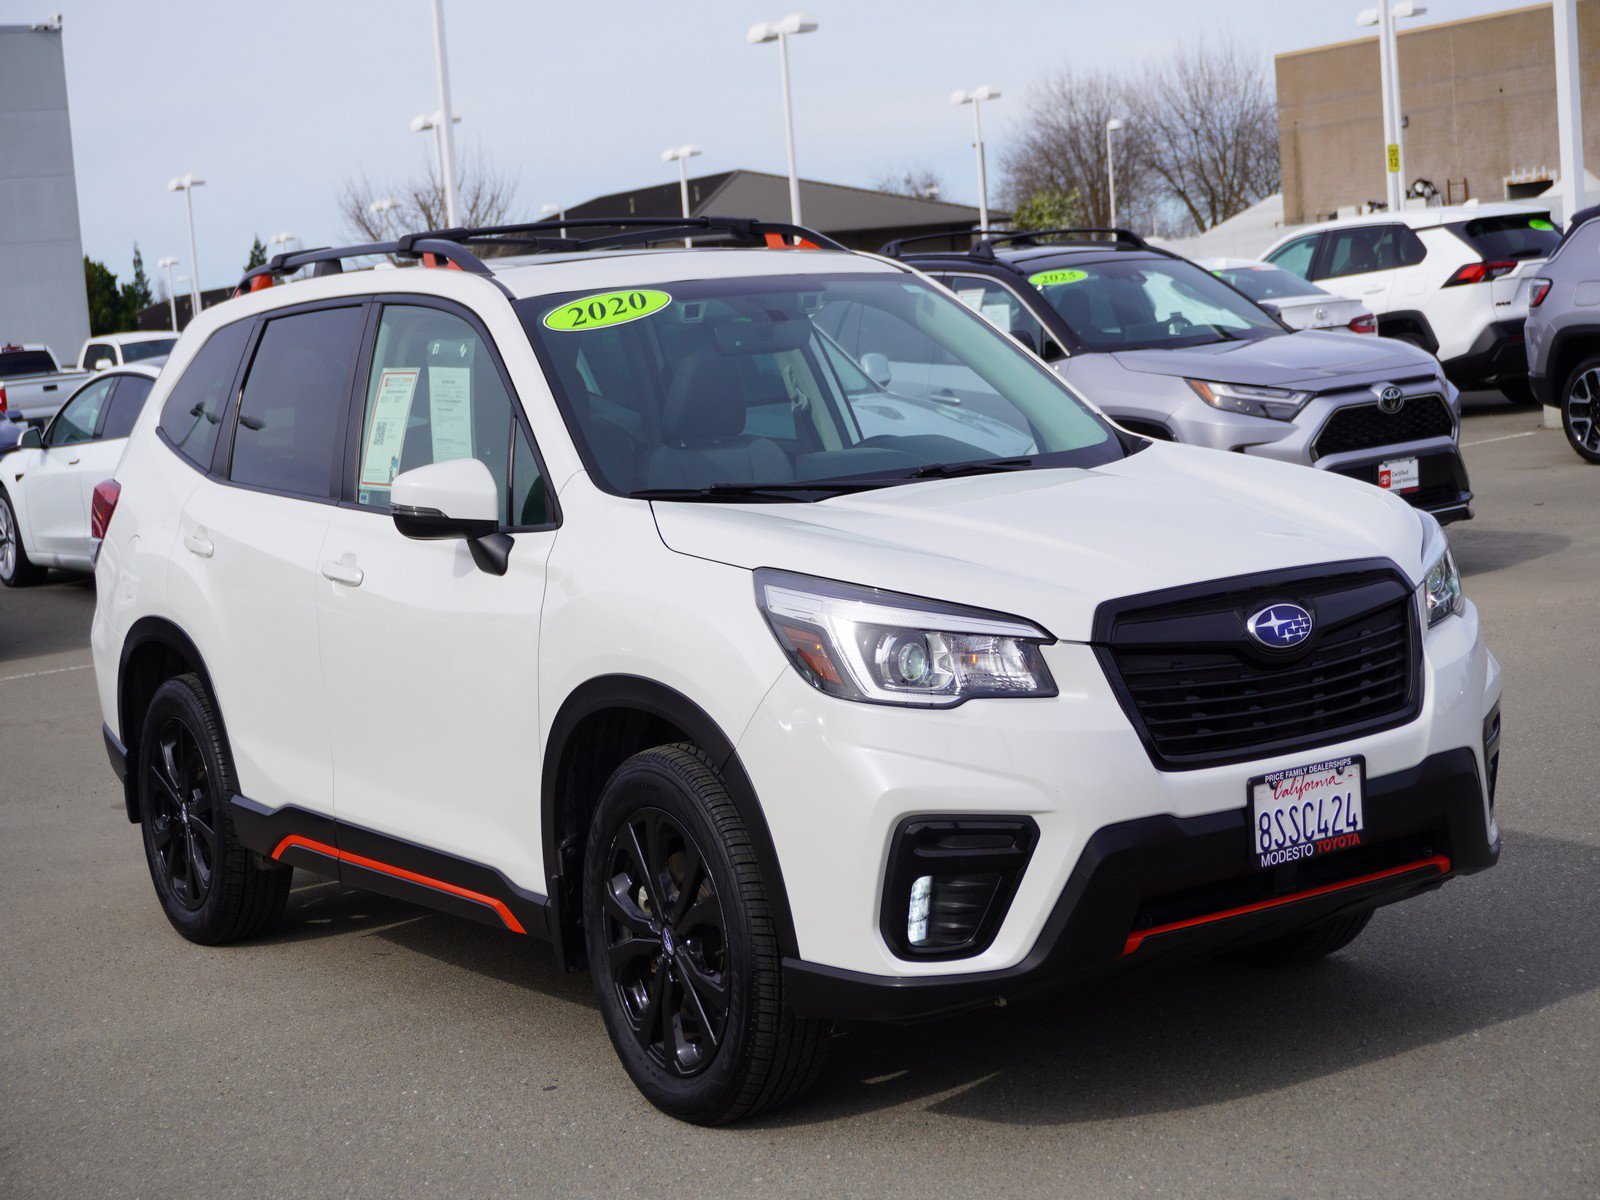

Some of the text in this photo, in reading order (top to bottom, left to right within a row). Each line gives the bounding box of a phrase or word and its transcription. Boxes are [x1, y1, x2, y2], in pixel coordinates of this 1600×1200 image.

[1042, 271, 1076, 284] 2025
[567, 292, 647, 327] 2020
[1264, 757, 1352, 783] PRICE FAMILY DEALERSHIPS
[1273, 771, 1343, 801] California
[1258, 792, 1358, 853] 8SSC424
[1260, 832, 1361, 868] MODESTO TOYOTA
